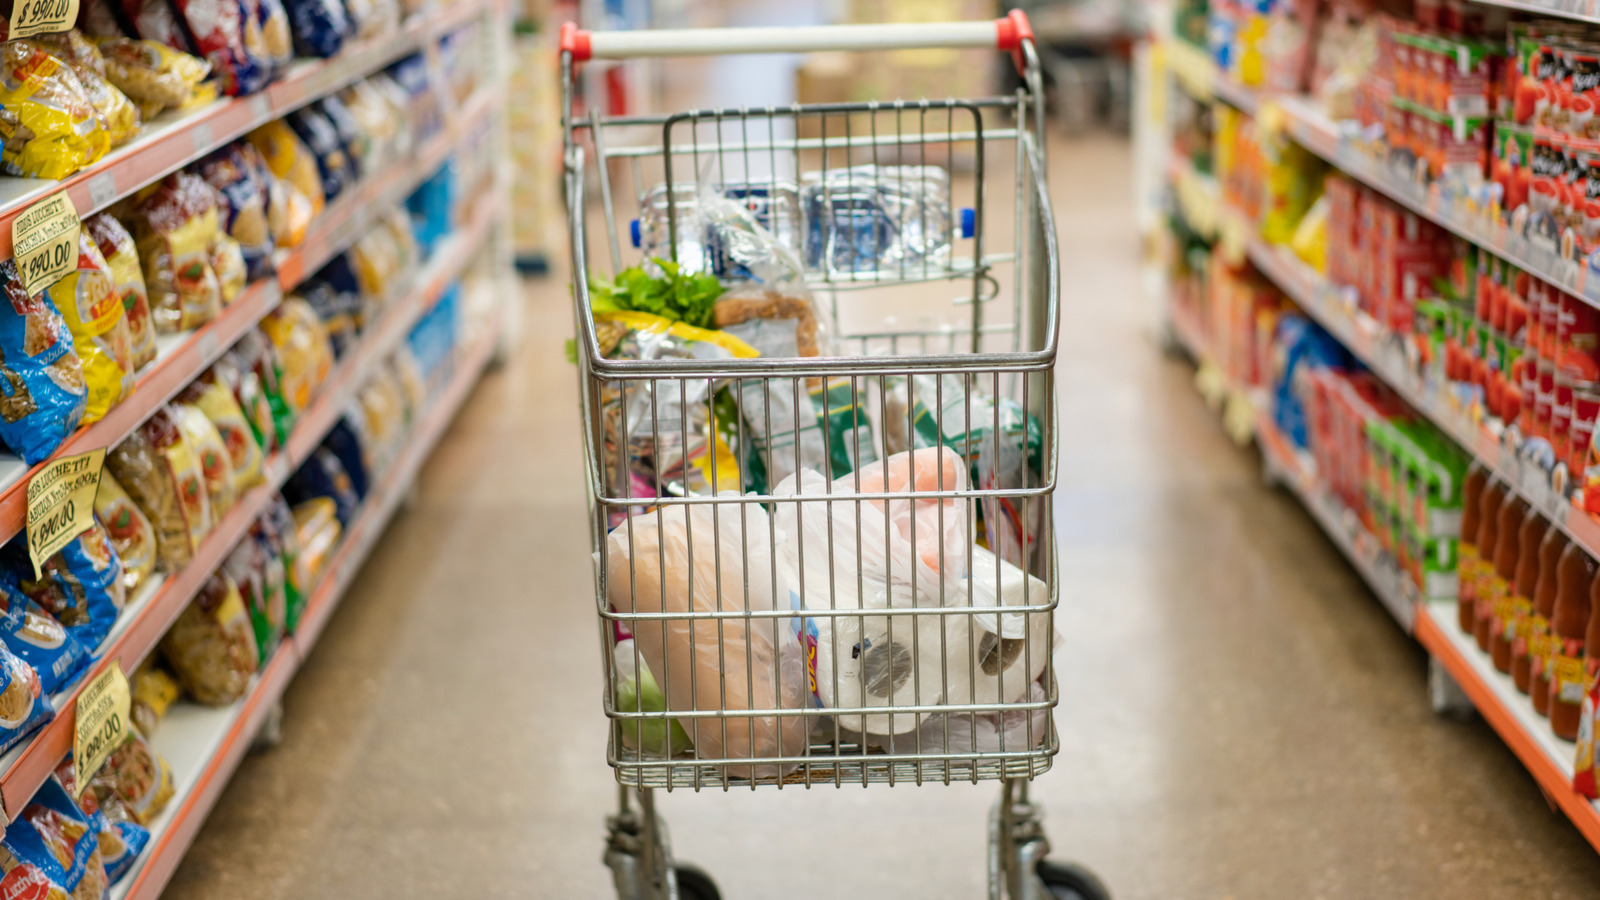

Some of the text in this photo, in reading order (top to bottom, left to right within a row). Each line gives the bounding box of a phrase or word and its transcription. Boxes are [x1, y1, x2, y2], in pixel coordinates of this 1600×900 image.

[17, 0, 69, 27] $ 990.00
[29, 240, 71, 280] 990.00
[41, 456, 91, 488] LUCCHETTI
[38, 499, 75, 547] 990.00
